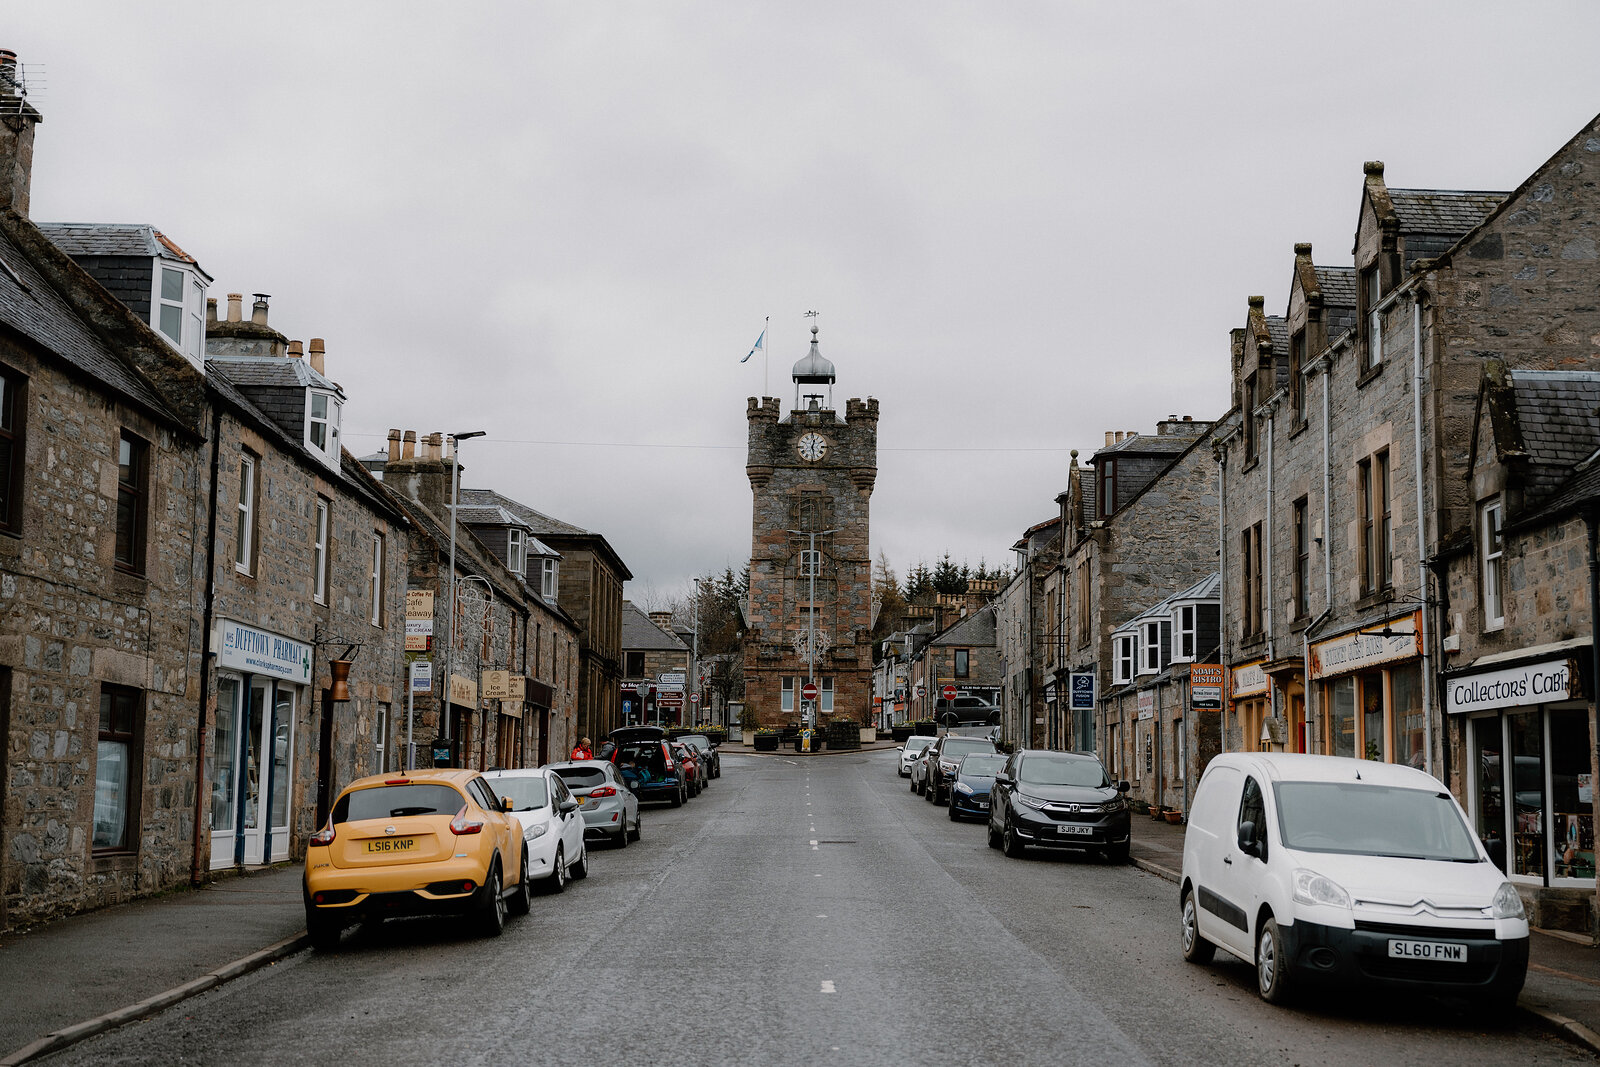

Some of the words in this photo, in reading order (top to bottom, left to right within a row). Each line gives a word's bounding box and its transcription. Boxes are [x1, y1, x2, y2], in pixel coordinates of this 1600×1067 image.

[406, 610, 432, 618] eaway
[235, 627, 269, 656] DUFFTOWN
[273, 638, 303, 665] PHARMACY
[1192, 668, 1222, 676] NOAH'S
[368, 841, 391, 852] LS16
[393, 839, 414, 850] KNP
[1395, 942, 1431, 957] SL60
[1434, 945, 1461, 959] FNW
